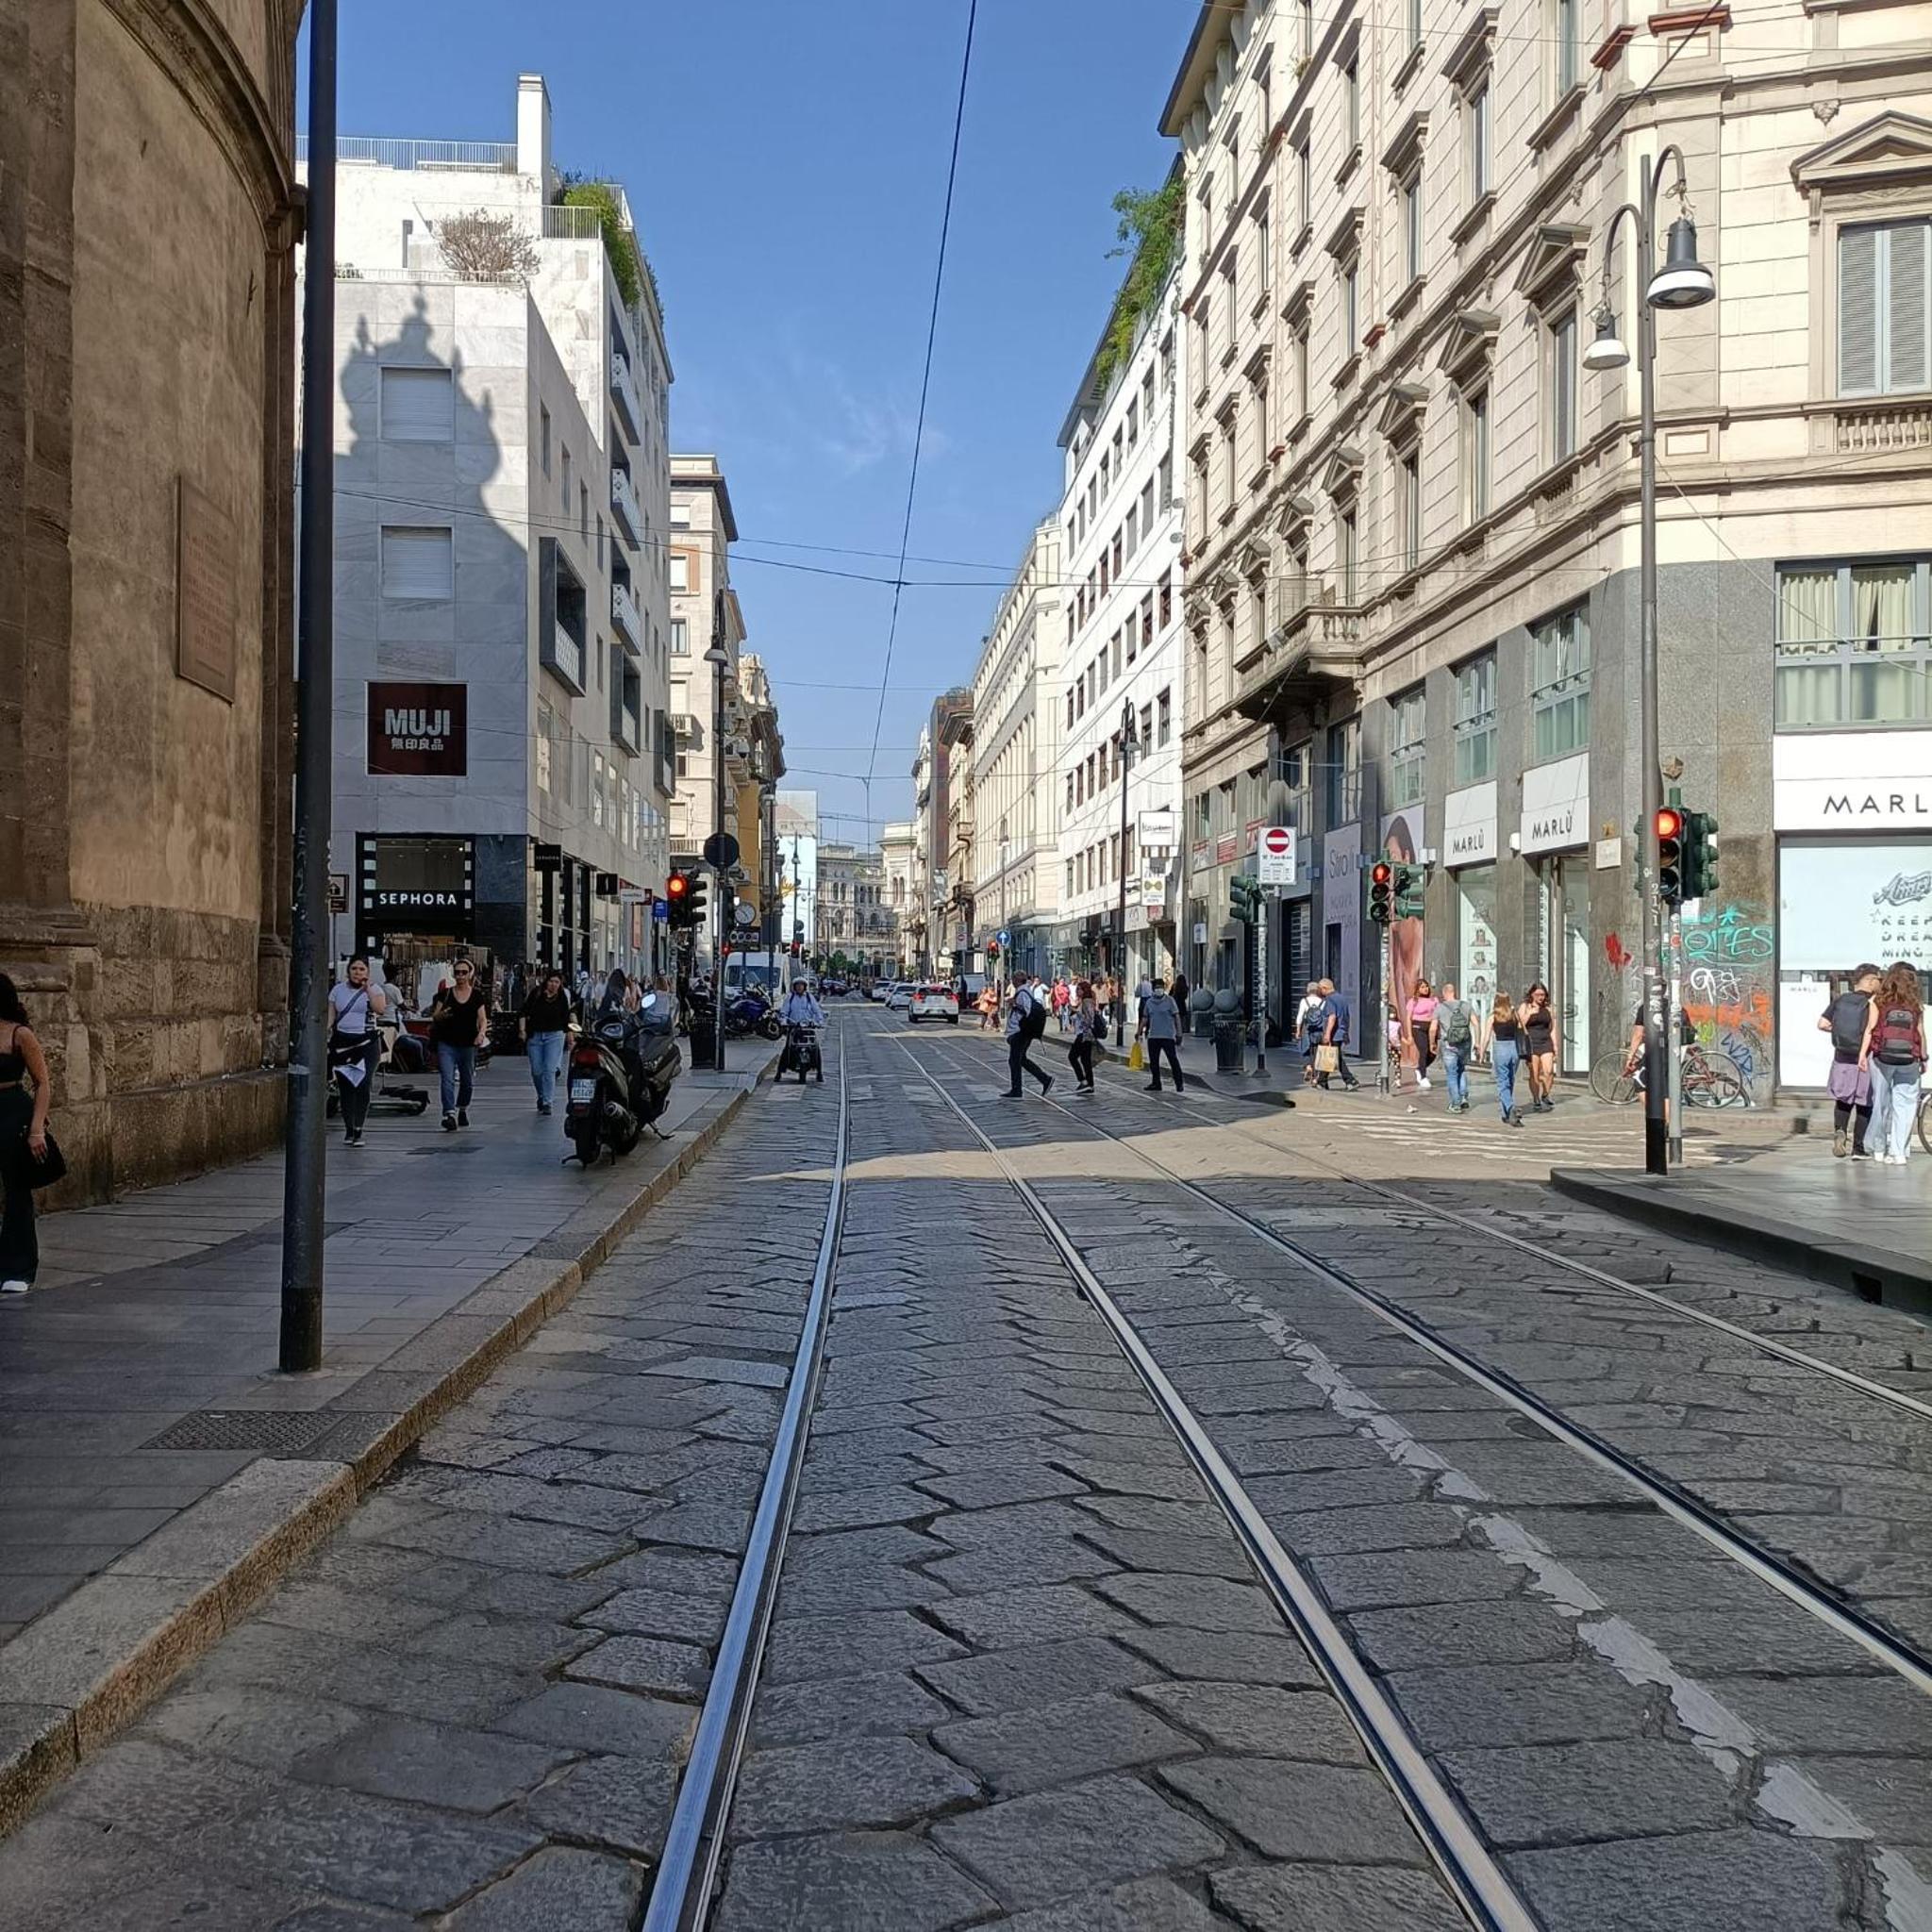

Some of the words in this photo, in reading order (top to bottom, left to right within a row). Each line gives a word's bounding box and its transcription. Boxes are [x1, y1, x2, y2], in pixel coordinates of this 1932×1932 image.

[385, 708, 450, 736] MUJI
[391, 737, 444, 751] 無印良品
[1824, 793, 1928, 814] MARL
[1532, 809, 1573, 840] MARLÙ
[1453, 828, 1485, 854] MARLÙ
[379, 892, 457, 906] SEPHORA
